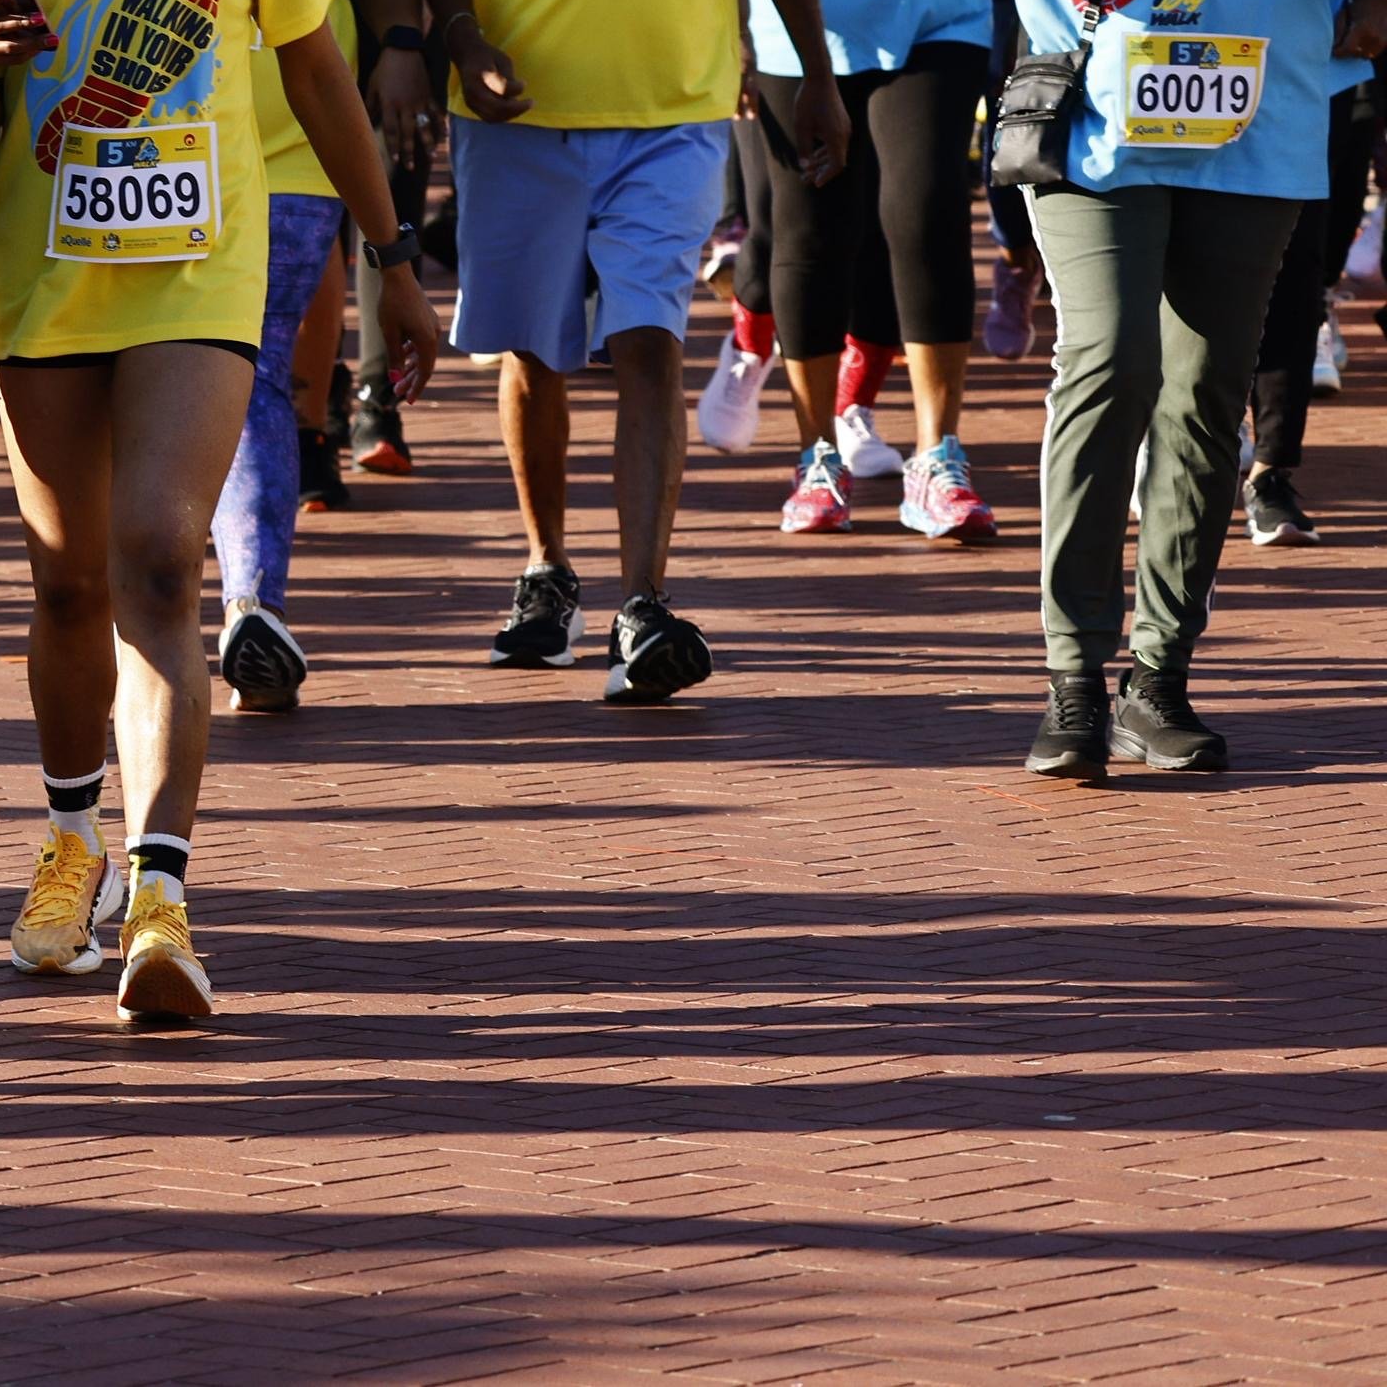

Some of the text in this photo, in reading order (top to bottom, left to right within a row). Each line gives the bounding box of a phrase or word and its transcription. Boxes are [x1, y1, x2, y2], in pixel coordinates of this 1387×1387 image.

[101, 12, 139, 53] IN
[1151, 12, 1202, 26] WALK
[1178, 44, 1190, 63] 5
[1137, 73, 1249, 113] 60019
[108, 142, 123, 164] 5
[66, 172, 200, 222] 58069
